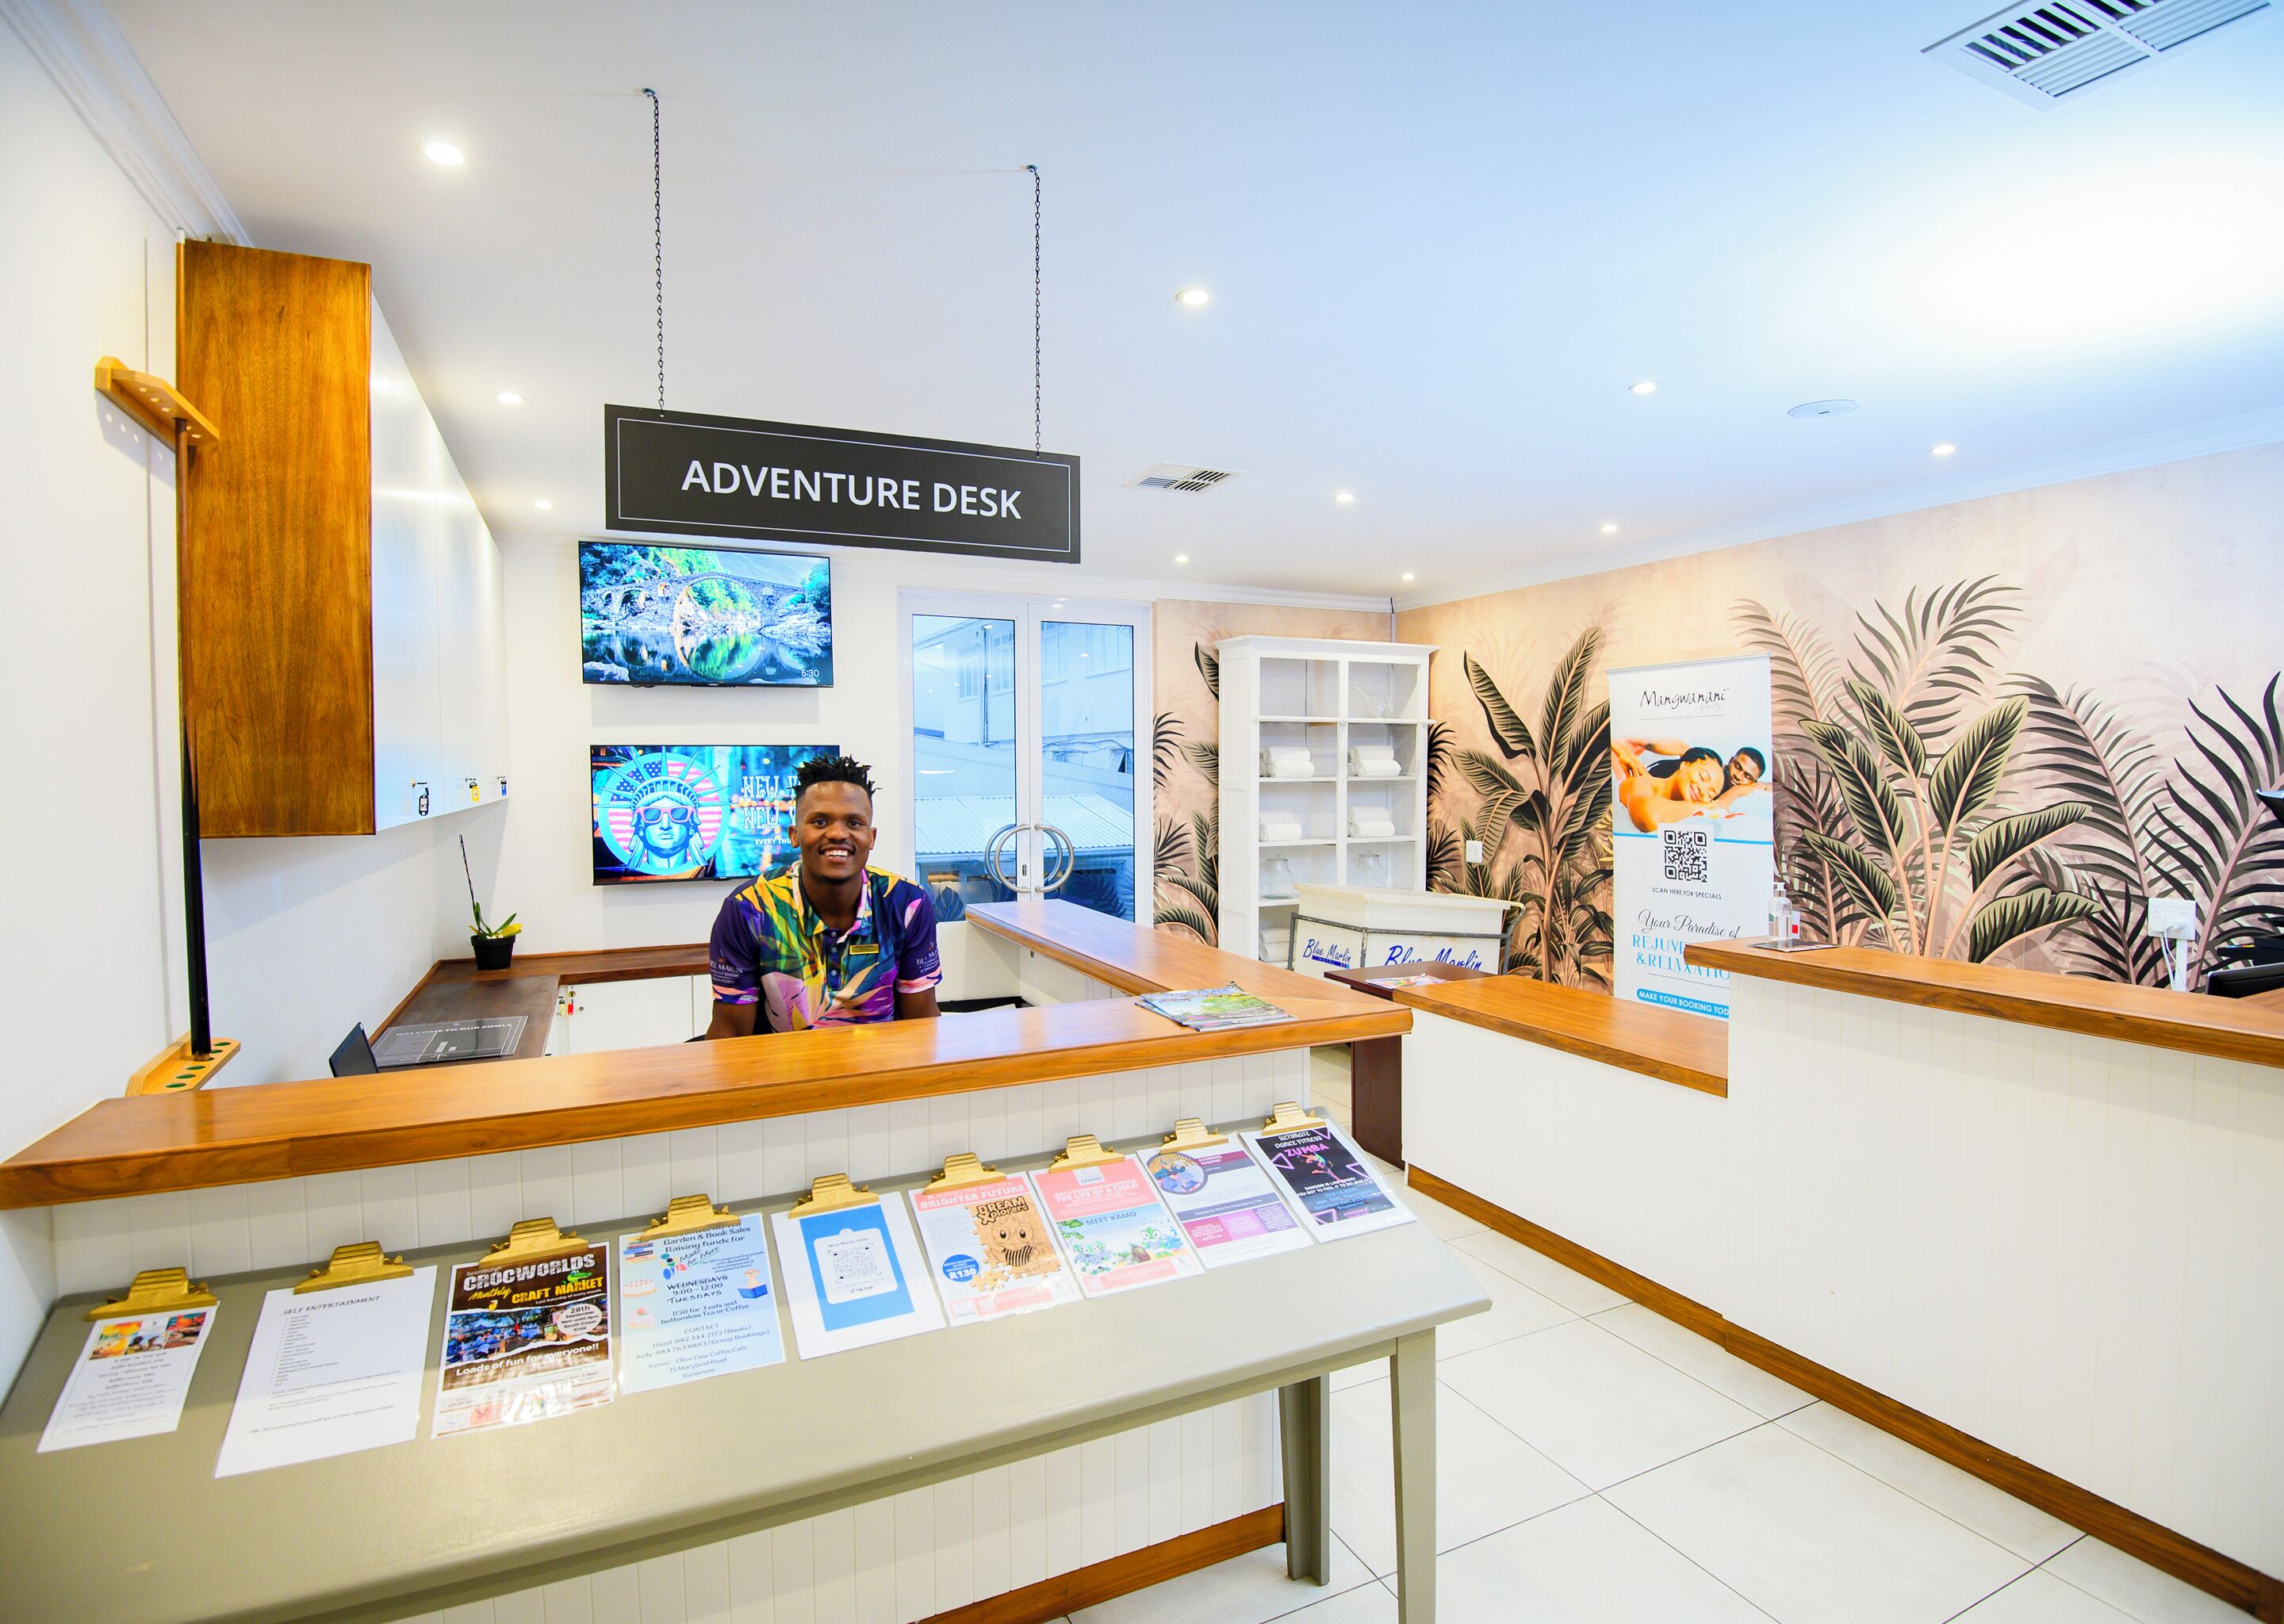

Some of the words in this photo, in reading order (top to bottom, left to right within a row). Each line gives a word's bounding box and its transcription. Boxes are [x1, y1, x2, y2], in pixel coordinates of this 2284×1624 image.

[680, 459, 921, 511] ADVENTURE
[932, 481, 1023, 520] DESK
[801, 668, 820, 677] 5:30
[1639, 688, 1726, 710] Mangwanani
[742, 776, 780, 799] NEW
[743, 806, 780, 829] NEW
[1695, 891, 1723, 900] SPECIALS
[1638, 909, 1671, 933] Your
[1673, 914, 1726, 937] Paradise
[1303, 939, 1324, 958] Blue
[1326, 944, 1351, 963] Marlin
[1638, 990, 1657, 1001] MAKE
[1659, 994, 1677, 1005] YOUR
[1678, 998, 1712, 1013] BOOKING
[1713, 1006, 1730, 1016] TOD
[1284, 1143, 1330, 1157] ZUMBA
[920, 1193, 979, 1209] BRIGHTER
[982, 1185, 1025, 1199] FUTURE
[977, 1196, 1026, 1214] DREAM
[976, 1205, 1029, 1225] Xplorers
[1086, 1216, 1108, 1226] MEET
[1109, 1211, 1136, 1221] KAMO
[663, 1234, 696, 1246] Garden
[705, 1229, 728, 1239] Book
[729, 1226, 751, 1235] Sales
[665, 1242, 700, 1253] Raising
[702, 1239, 730, 1247] funds
[463, 1253, 596, 1292] CROCWORLDS
[667, 1274, 728, 1290] WEDNESDAYS
[948, 1268, 977, 1280] R130
[468, 1286, 512, 1301] Monthly
[512, 1288, 550, 1304] CRAFT
[555, 1277, 604, 1296] MARKET
[666, 1289, 722, 1304] TUESDAYS
[673, 1287, 692, 1296] 9:00
[701, 1282, 723, 1292] 12:00
[306, 1295, 381, 1312] ENTERTAINMENT
[661, 1314, 701, 1324] bottomless
[725, 1304, 749, 1312] Coffee
[684, 1323, 719, 1334] CONTACT
[456, 1363, 490, 1377] Loads
[491, 1360, 504, 1370] of
[505, 1357, 524, 1368] fun
[526, 1354, 543, 1364] for
[543, 1342, 600, 1361] everyone!!
